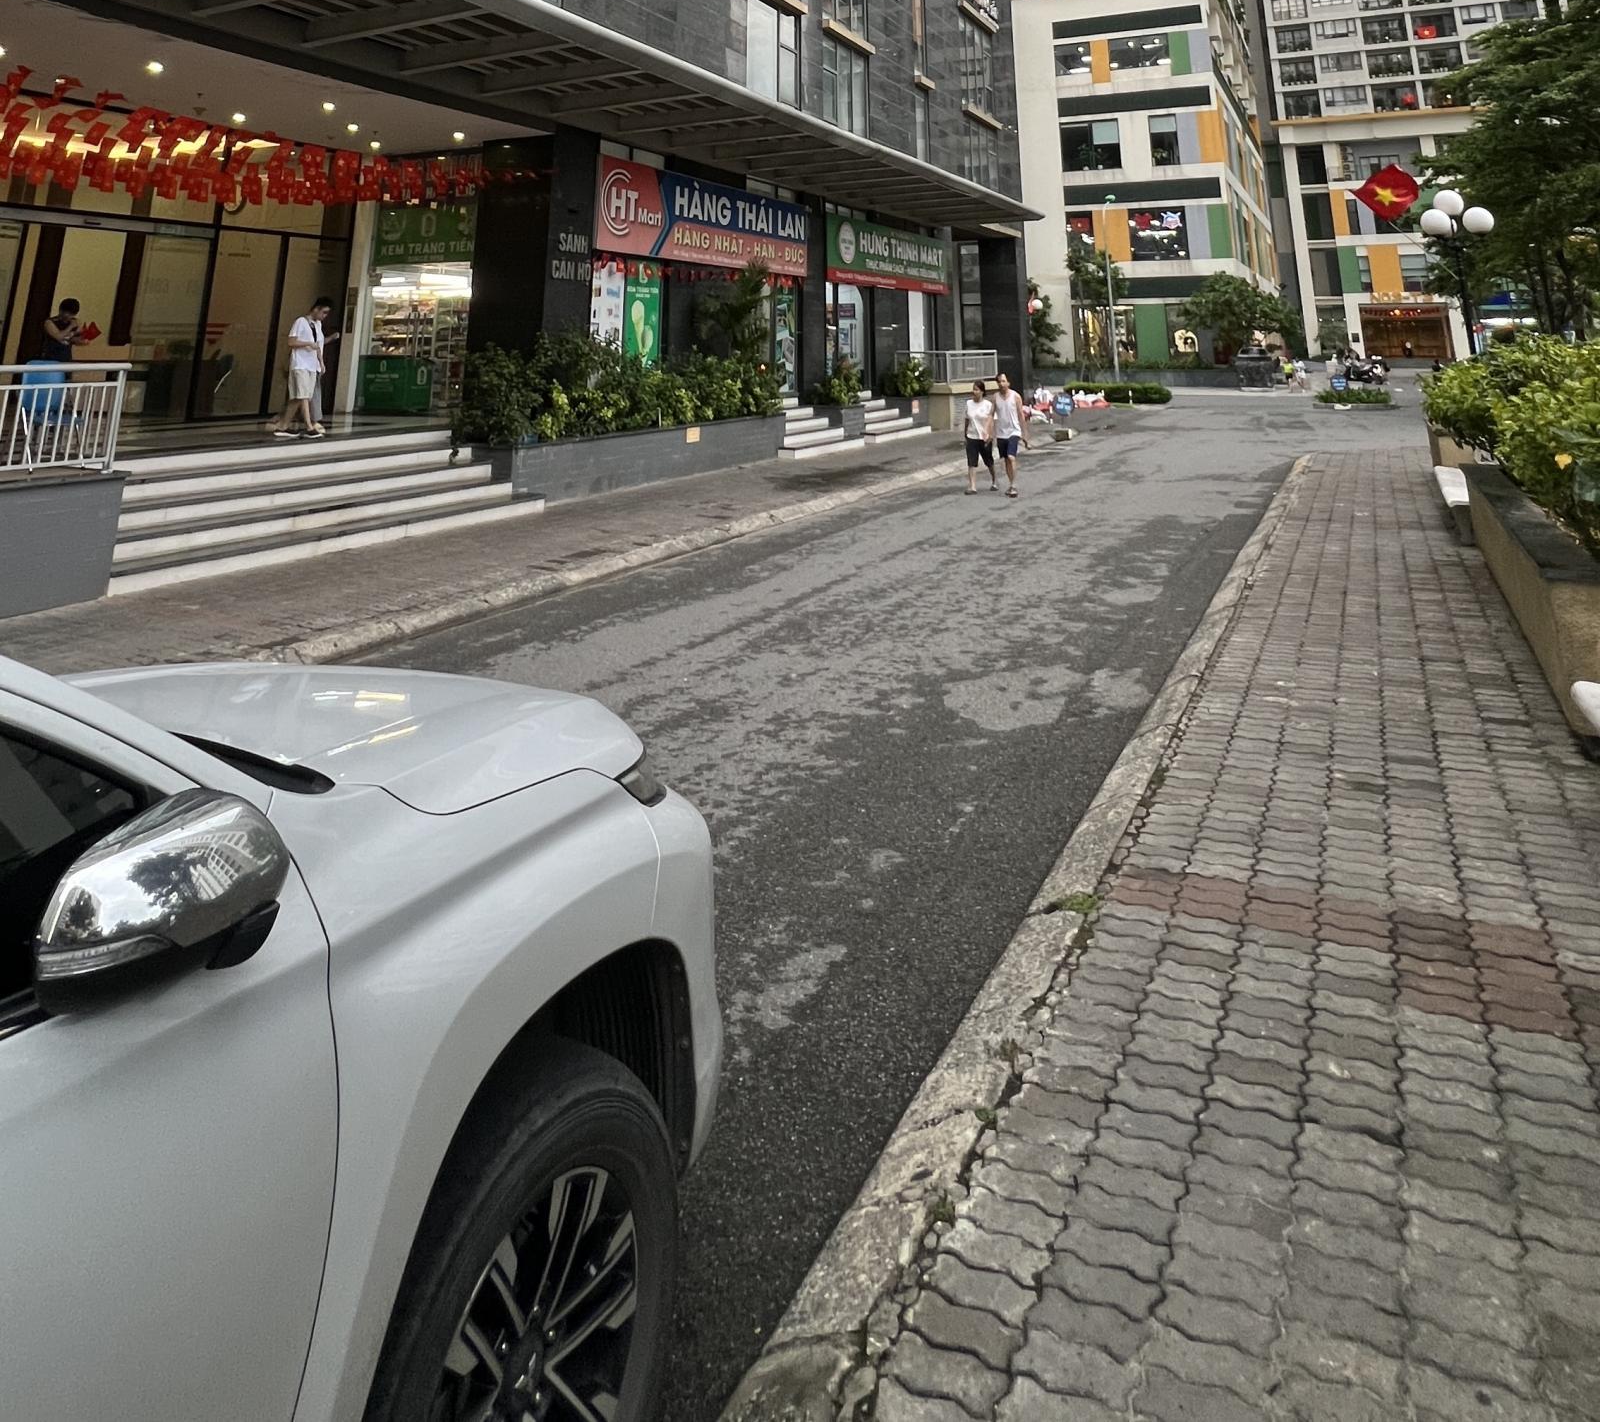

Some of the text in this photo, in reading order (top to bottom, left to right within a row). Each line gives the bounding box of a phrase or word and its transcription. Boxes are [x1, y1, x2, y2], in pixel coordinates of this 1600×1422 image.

[637, 206, 663, 227] Mart
[675, 181, 806, 241] HÀNG THÁI LAN
[380, 243, 405, 256] KEM
[674, 225, 710, 249] HÀNG
[714, 234, 744, 257] NHẬT
[753, 238, 776, 259] HÀN
[784, 244, 805, 264] ĐỨC
[859, 230, 890, 258] HƯNG
[890, 238, 919, 266] THỊNH
[920, 246, 943, 267] MART
